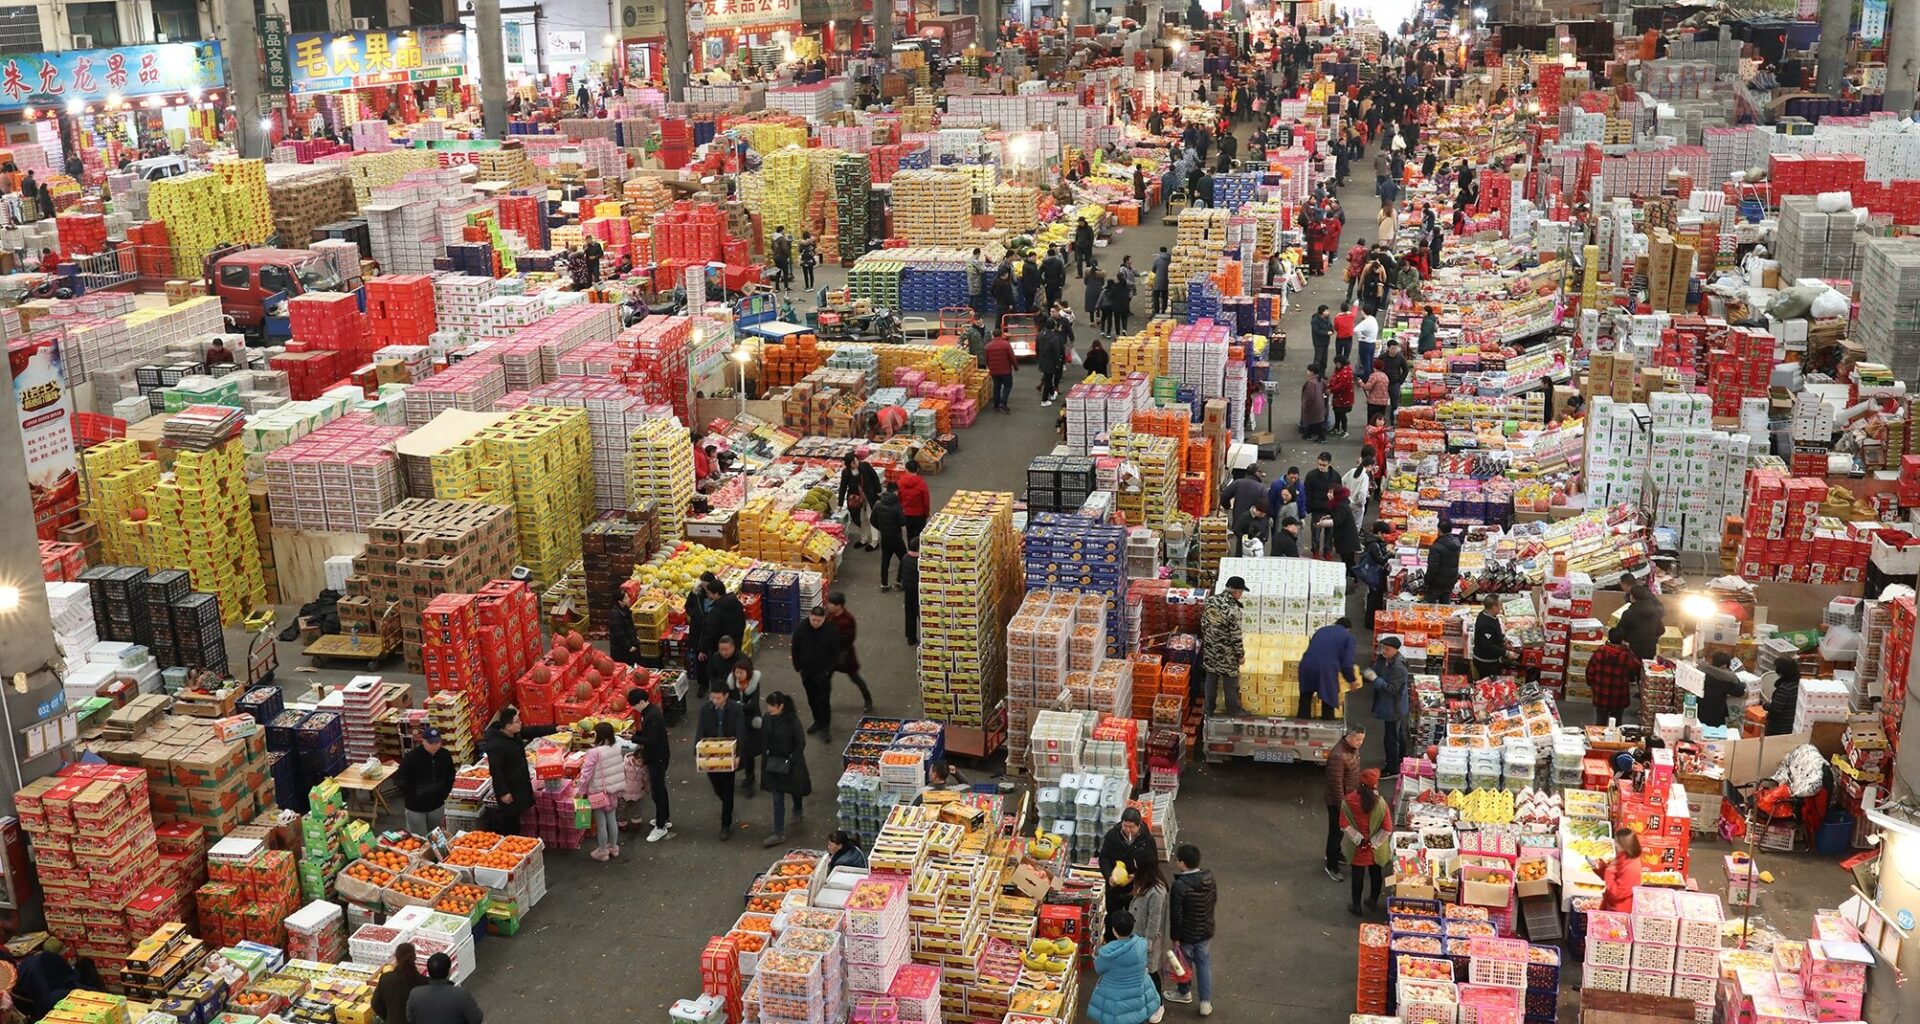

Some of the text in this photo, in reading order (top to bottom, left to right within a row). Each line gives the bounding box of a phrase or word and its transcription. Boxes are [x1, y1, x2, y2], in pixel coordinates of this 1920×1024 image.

[3, 53, 161, 102] 朱允龙果品
[265, 20, 285, 87] 果品交易区
[295, 31, 422, 78] 毛氏果品
